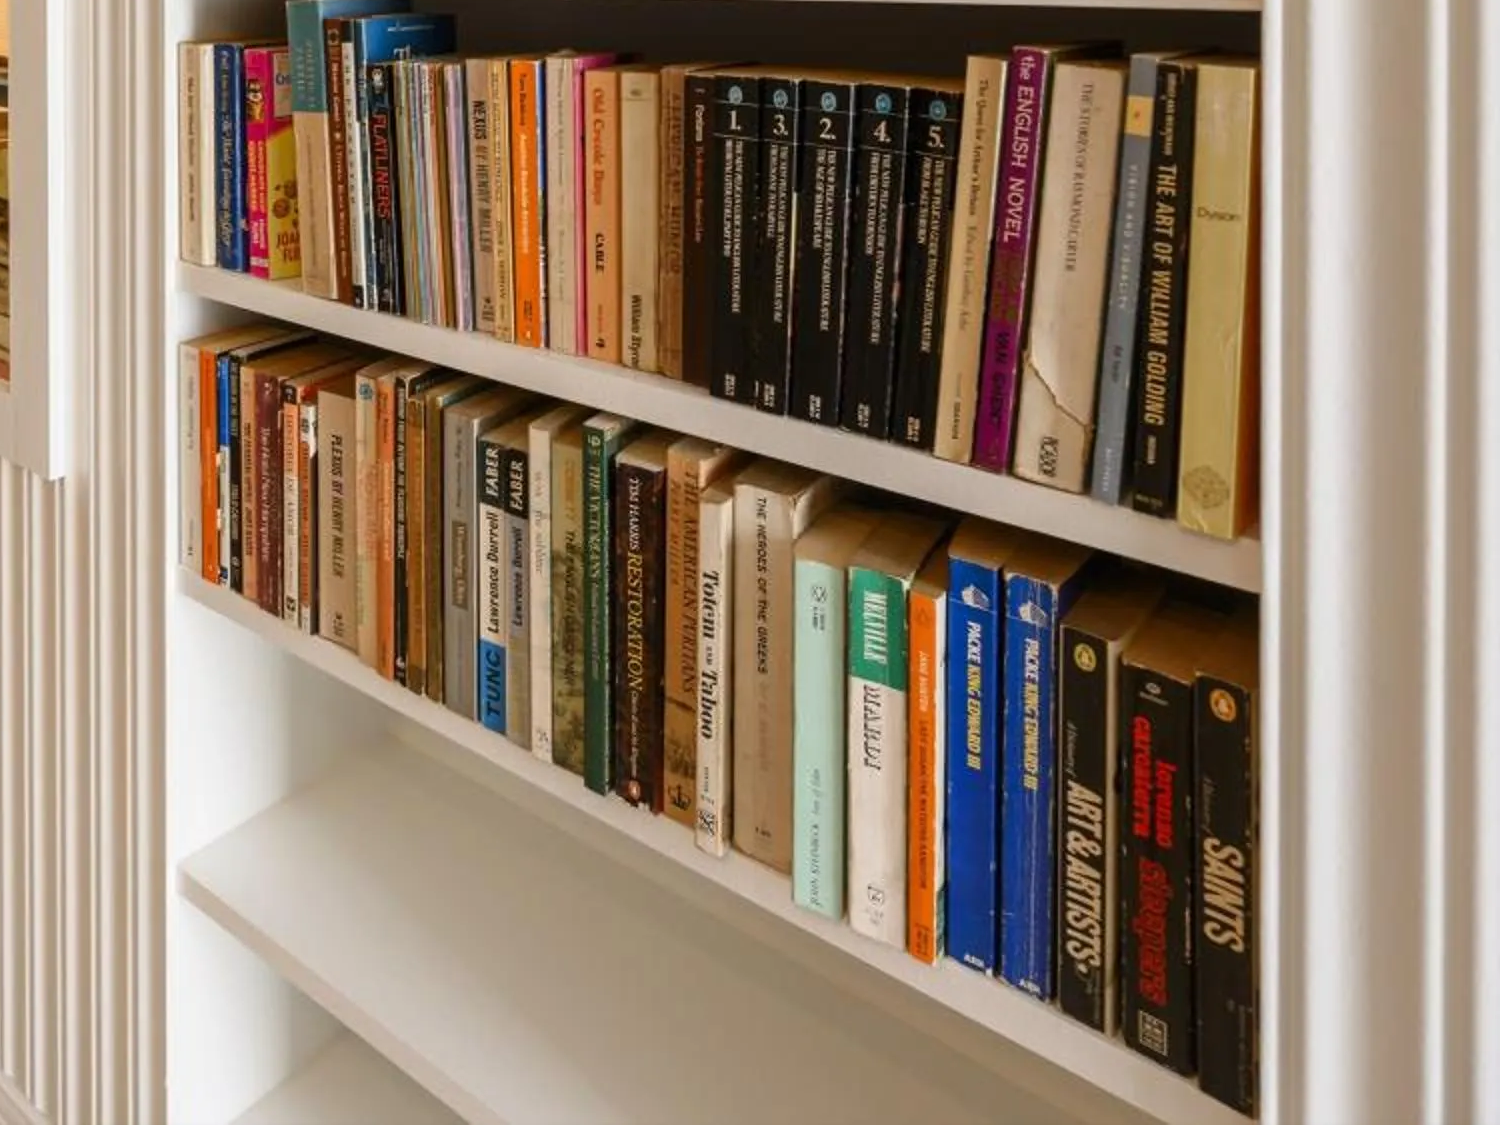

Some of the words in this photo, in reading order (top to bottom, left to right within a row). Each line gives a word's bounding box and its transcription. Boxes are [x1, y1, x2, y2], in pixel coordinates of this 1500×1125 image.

[1018, 55, 1037, 80] the
[473, 100, 486, 139] NEXUS
[729, 112, 741, 132] 1.
[772, 115, 788, 137] 3.
[819, 118, 836, 140] 2.
[873, 122, 891, 143] 4.
[927, 126, 944, 148] 5.
[1010, 85, 1034, 167] ENGLISH
[372, 113, 390, 219] FLATLINERS
[475, 164, 489, 203] HENRY
[1155, 162, 1177, 200] THE
[1003, 177, 1025, 242] NOVEL
[1153, 201, 1175, 235] ART
[1197, 208, 1239, 222] Dyson
[595, 233, 604, 273] CABLE
[1152, 241, 1172, 264] OF
[1148, 269, 1171, 345] WILLIAM
[1144, 350, 1167, 425] GOLDING
[331, 433, 343, 478] PLEXUS
[485, 446, 498, 496] FABER
[331, 479, 343, 494] BY
[510, 459, 523, 511] FABER
[628, 475, 639, 504] TIM
[684, 470, 697, 506] THE
[757, 497, 766, 519] THE
[331, 495, 343, 534] HENRY
[486, 511, 499, 564] Durrell
[628, 503, 639, 551] HARRIS
[331, 533, 343, 578] MILLER
[512, 525, 522, 569] Durrell
[683, 516, 697, 608] AMERICAN
[757, 524, 766, 573] HEROES
[486, 566, 500, 634] Lawrence
[511, 569, 522, 629] Lawrence
[702, 569, 719, 639] Totem
[757, 576, 766, 595] OF
[626, 551, 643, 691] RESTORATION
[757, 597, 766, 623] THE
[862, 590, 887, 664] MELVILLE
[682, 612, 696, 695] PURITANS
[757, 626, 766, 675] GREEKS
[967, 620, 980, 663] PACKE
[1024, 638, 1038, 680] PACKE
[484, 648, 500, 717] TUNC
[967, 664, 980, 697] KING
[1024, 682, 1038, 716] KING
[701, 668, 717, 741] Taboo
[967, 698, 980, 754] EDWARD
[863, 685, 881, 771] MARDI
[1023, 716, 1037, 772] EDWARD
[967, 753, 980, 770] III
[1132, 714, 1152, 841] carcaterra
[1065, 779, 1102, 837] ART
[1155, 760, 1176, 852] lorenzo
[1065, 826, 1102, 867] &
[1064, 854, 1102, 971] ARTISTS
[1203, 835, 1243, 955] SAINTS
[1132, 853, 1173, 1012] sleepers
